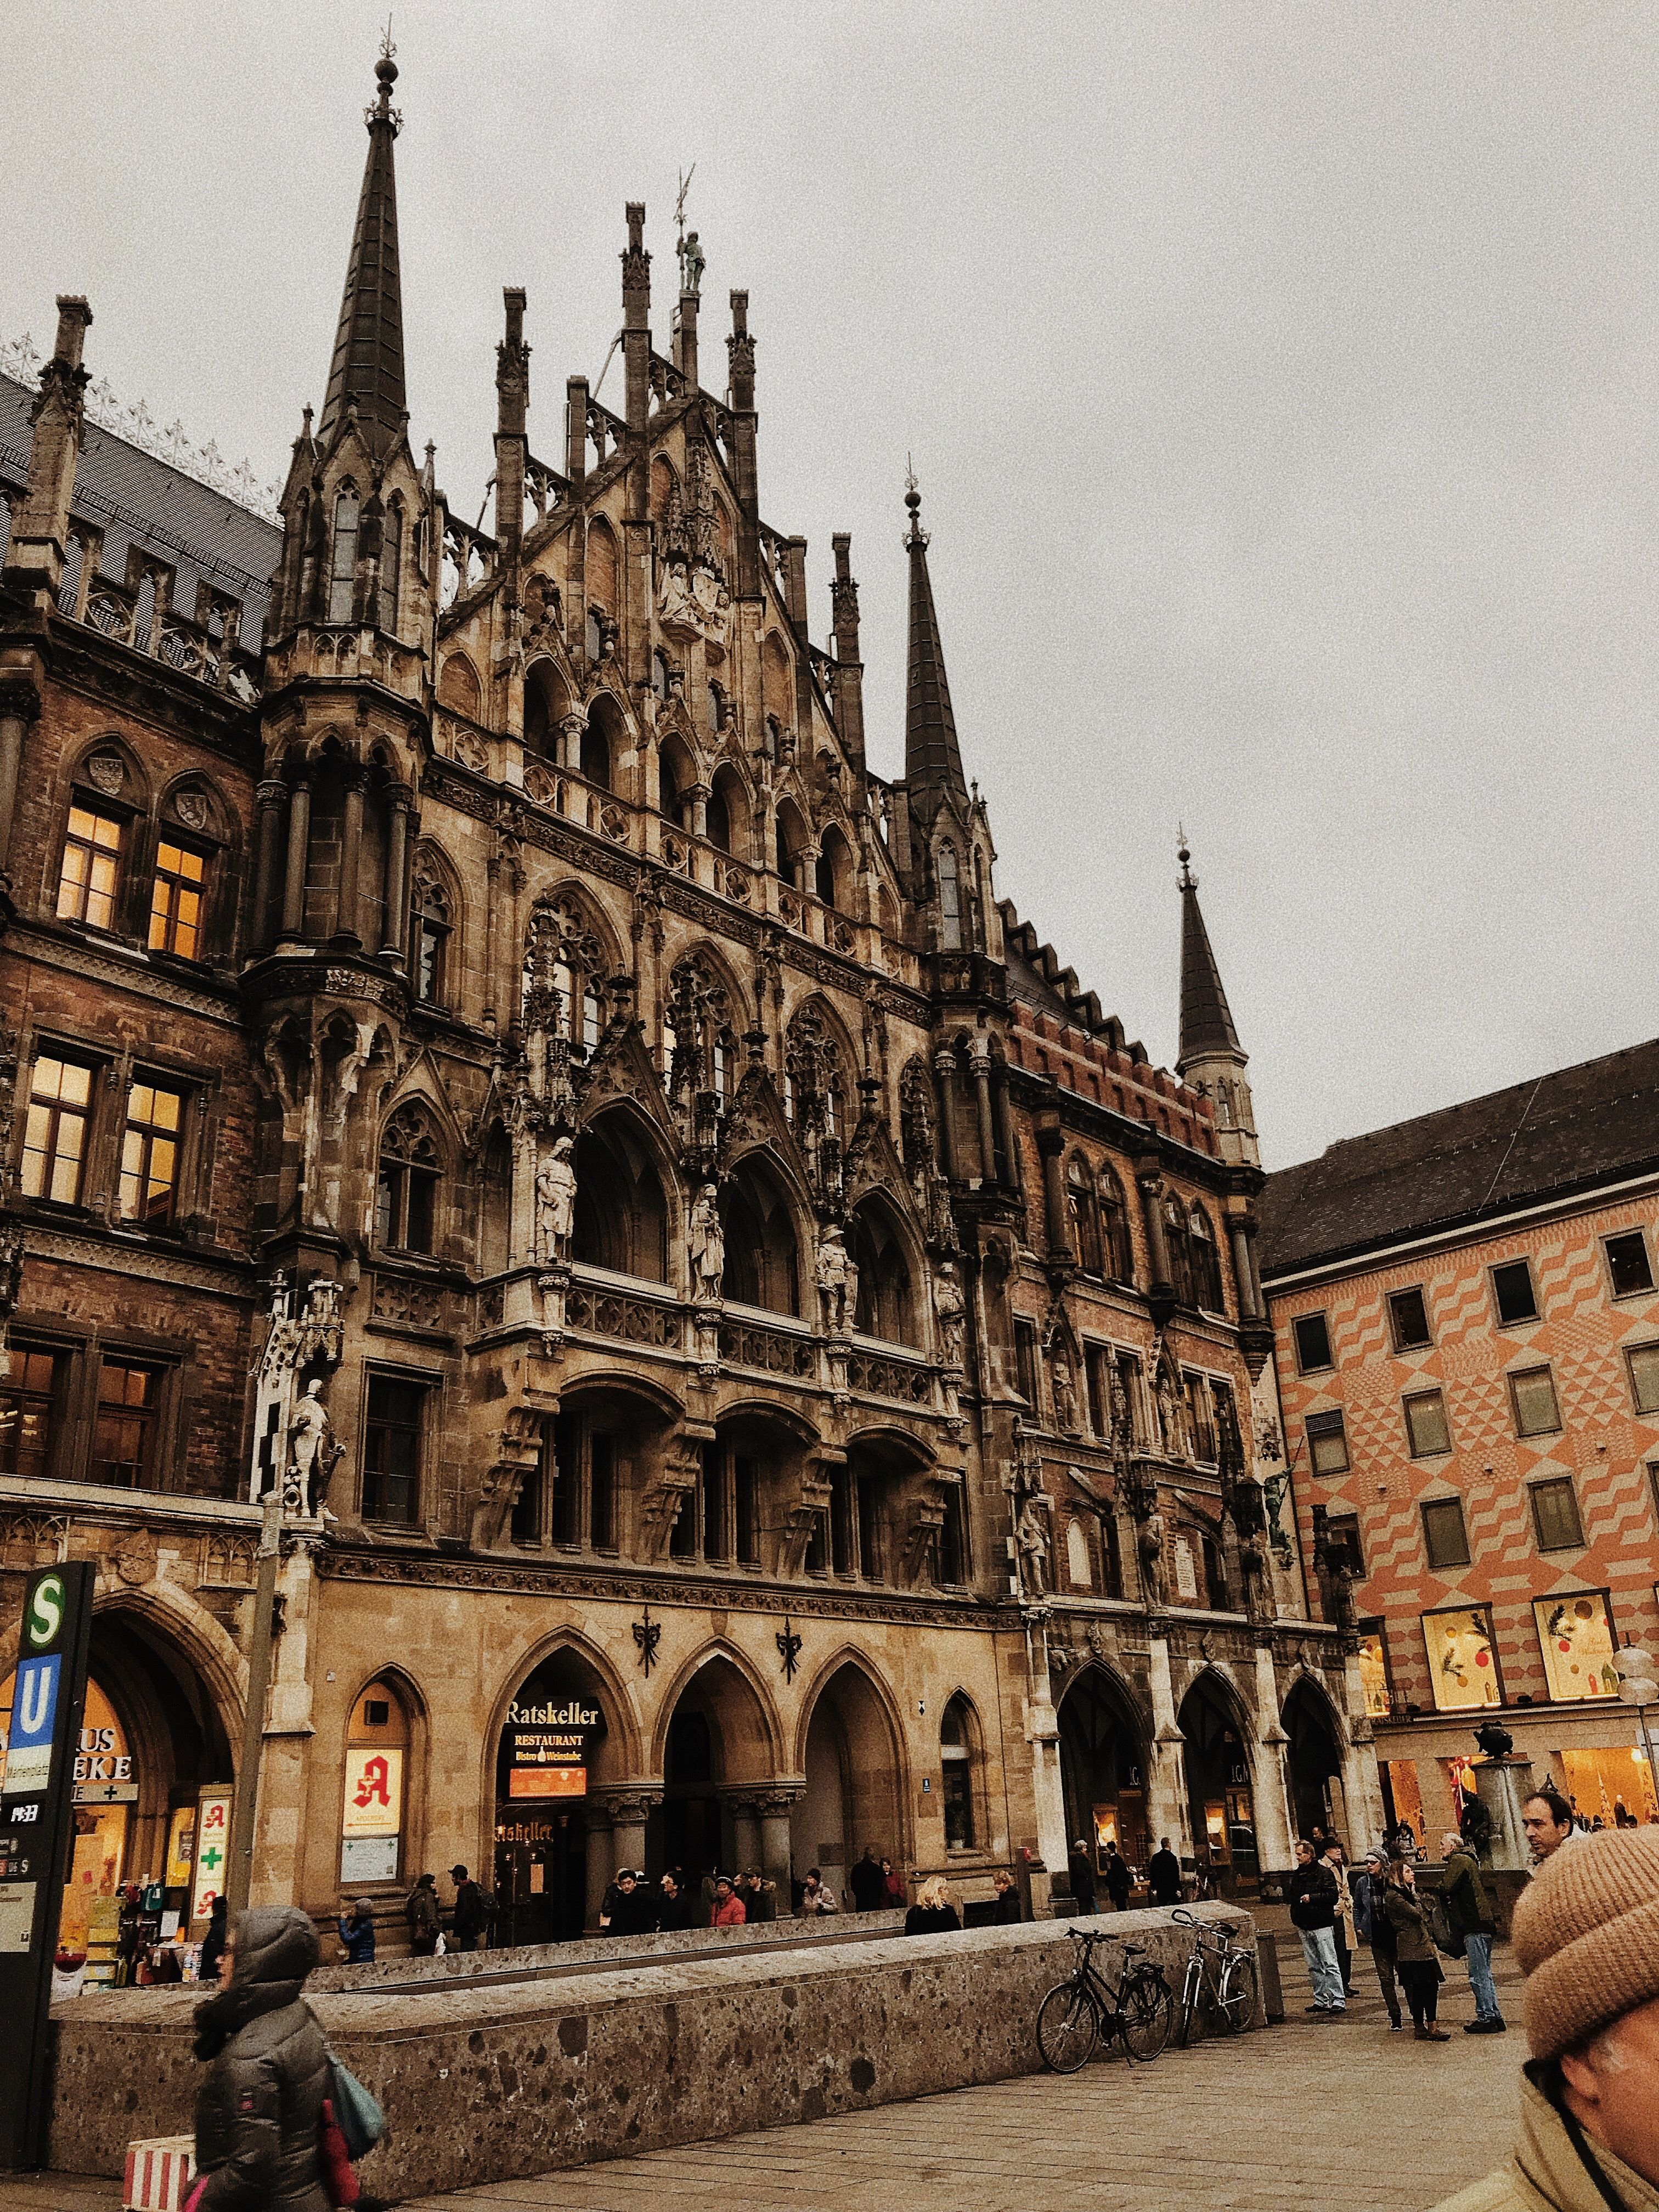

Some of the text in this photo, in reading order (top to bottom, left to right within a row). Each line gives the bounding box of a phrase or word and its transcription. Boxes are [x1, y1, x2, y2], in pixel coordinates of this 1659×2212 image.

[30, 1579, 60, 1643] S
[20, 1666, 52, 1734] U
[504, 1701, 599, 1725] Ratskeller
[514, 1735, 584, 1746] RESTAURANT
[516, 1751, 582, 1760] Bistro Weinstube
